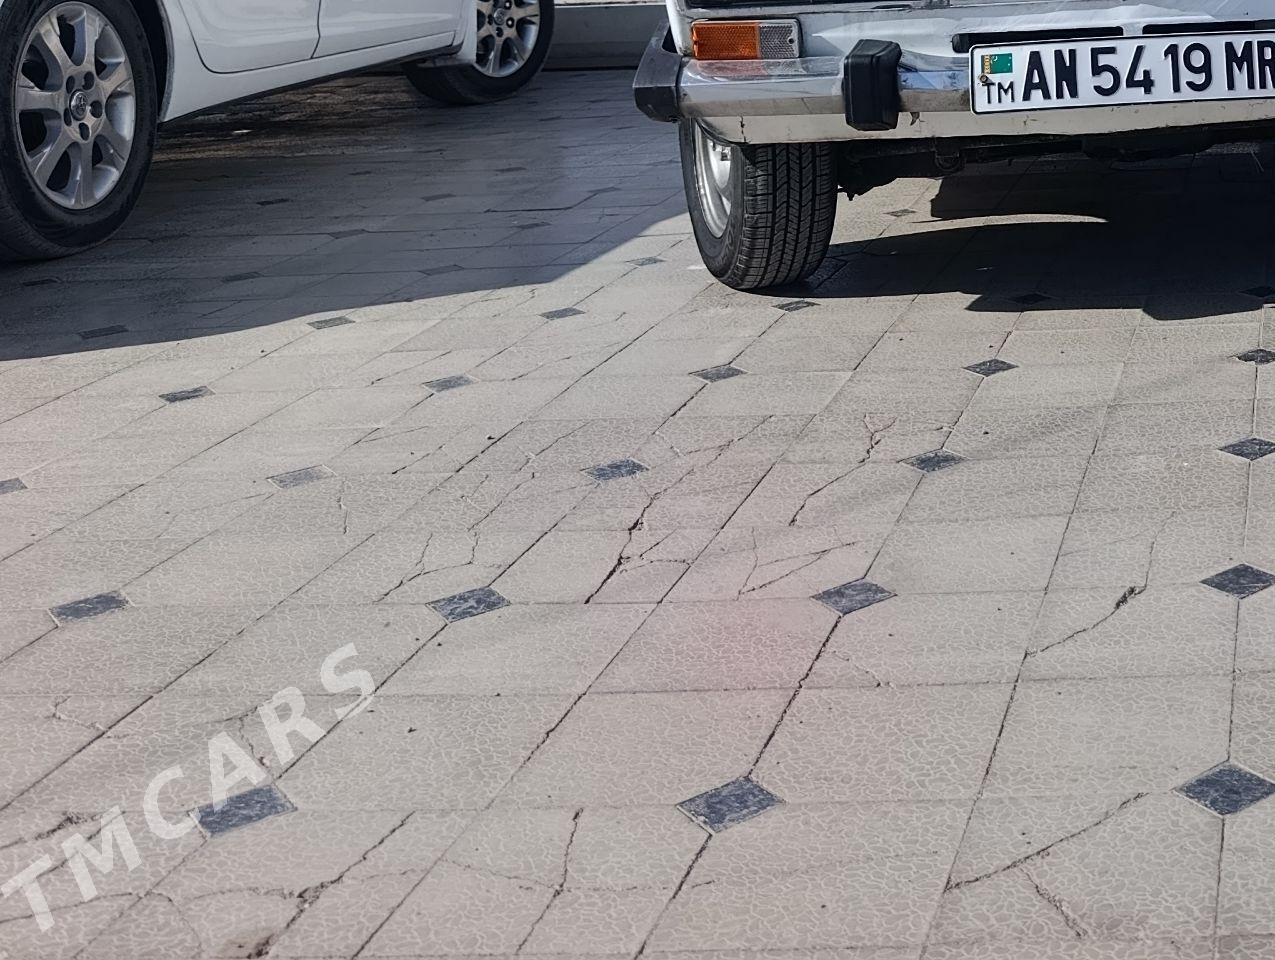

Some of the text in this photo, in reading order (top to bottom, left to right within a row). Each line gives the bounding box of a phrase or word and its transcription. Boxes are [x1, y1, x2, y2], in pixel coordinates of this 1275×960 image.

[982, 80, 1015, 104] TM
[1022, 49, 1079, 101] AN
[1090, 42, 1213, 97] 5419
